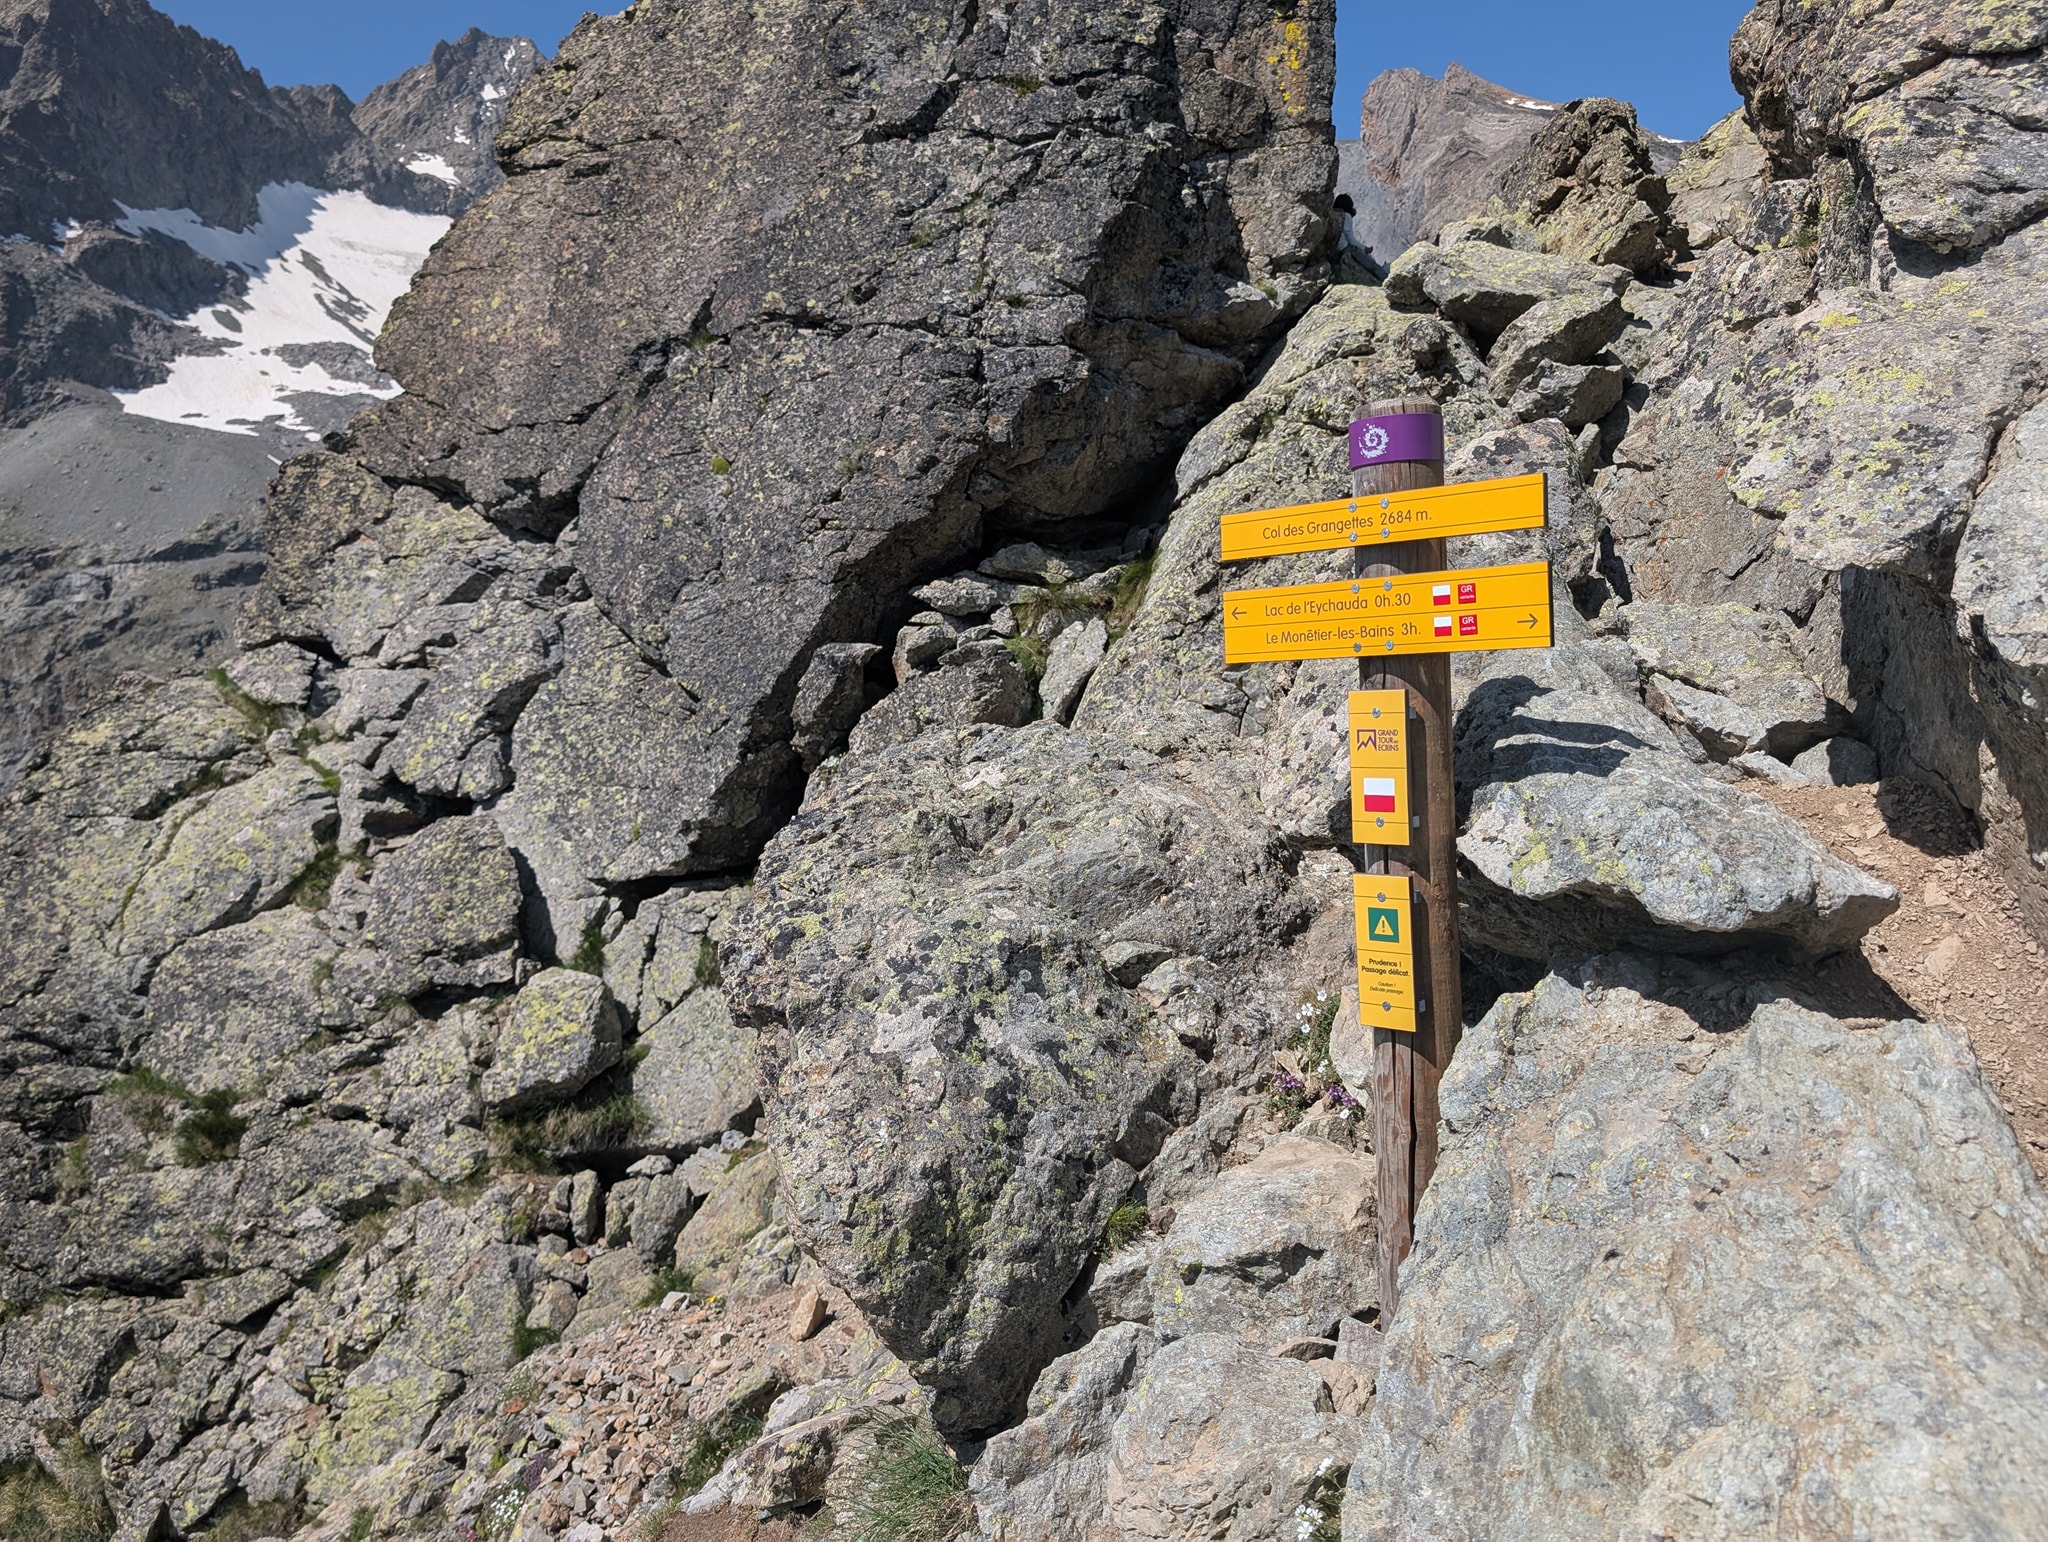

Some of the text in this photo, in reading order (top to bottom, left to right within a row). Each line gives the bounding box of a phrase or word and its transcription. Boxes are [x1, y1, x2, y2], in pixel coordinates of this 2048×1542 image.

[1262, 509, 1432, 540] Col des Grangettes 2684 m.
[1460, 584, 1473, 593] GR
[1265, 592, 1411, 617] Lac de l'Eychauda 0h.30
[1461, 616, 1474, 625] GR
[1266, 622, 1421, 644] Le Monêtier-les-Bains 3h.
[1377, 729, 1399, 737] GRAND
[1368, 958, 1398, 967] Prudence
[1361, 966, 1387, 975] Passage
